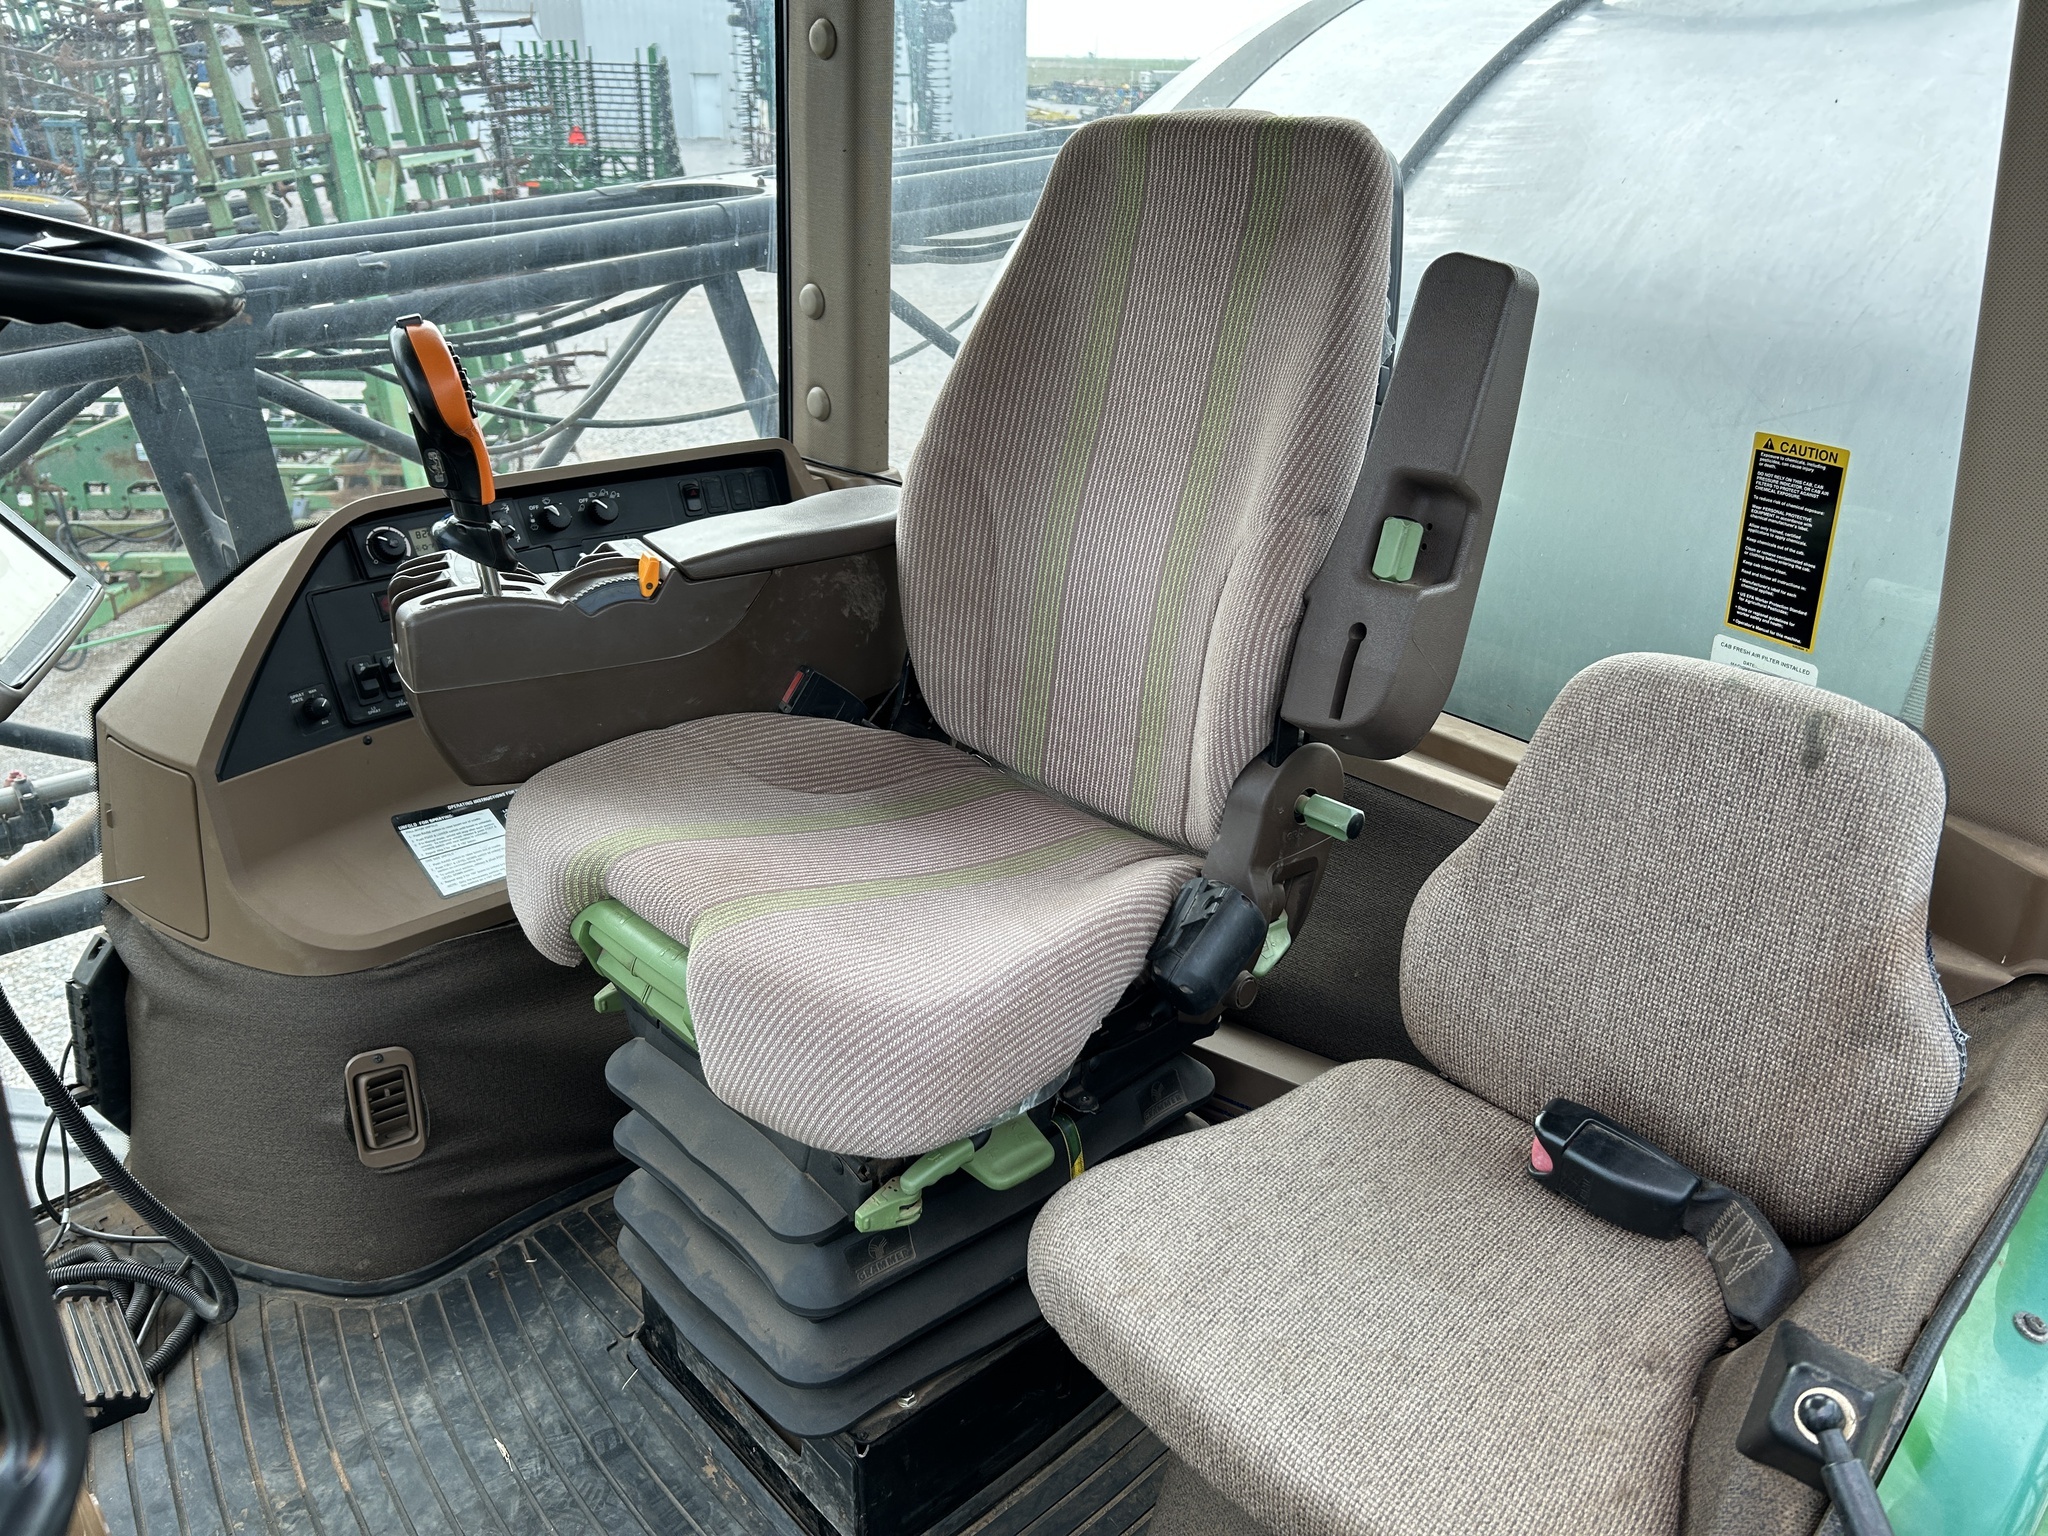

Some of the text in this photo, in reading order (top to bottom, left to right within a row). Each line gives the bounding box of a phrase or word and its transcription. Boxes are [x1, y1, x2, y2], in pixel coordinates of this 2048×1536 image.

[1779, 441, 1839, 464] CAUTION
[1760, 452, 1779, 461] Exposure
[1807, 462, 1827, 471] including
[1756, 476, 1779, 484] PRESSURE
[1755, 486, 1776, 494] CHEMICAL
[1780, 486, 1800, 494] PROTECT
[1800, 491, 1819, 499] AGAINST
[1751, 509, 1775, 518] EQUIPMENT
[1780, 516, 1803, 525] accordance
[1762, 507, 1785, 515] PERSONAL
[1785, 512, 1812, 522] PROTECTIVE
[1757, 540, 1776, 548] chemicals
[1749, 552, 1765, 560] clothing
[1778, 560, 1794, 569] entering
[1777, 555, 1803, 565] contaminated
[1741, 583, 1758, 591] chemical
[1777, 579, 1800, 589] instructions
[1755, 596, 1768, 604] Worker
[1769, 601, 1789, 610] Protection
[1789, 607, 1808, 616] Standard
[1721, 642, 1732, 650] CAB
[1733, 646, 1751, 656] FRESH
[1762, 655, 1780, 665] FILTER
[1781, 662, 1811, 676] INSTALLED
[290, 692, 304, 700] SPRAY
[447, 801, 473, 811] OPERATING
[473, 792, 506, 804] INSTRUCTIONS
[398, 822, 418, 831] UNFOLD
[856, 1248, 910, 1282] GRAMMER
